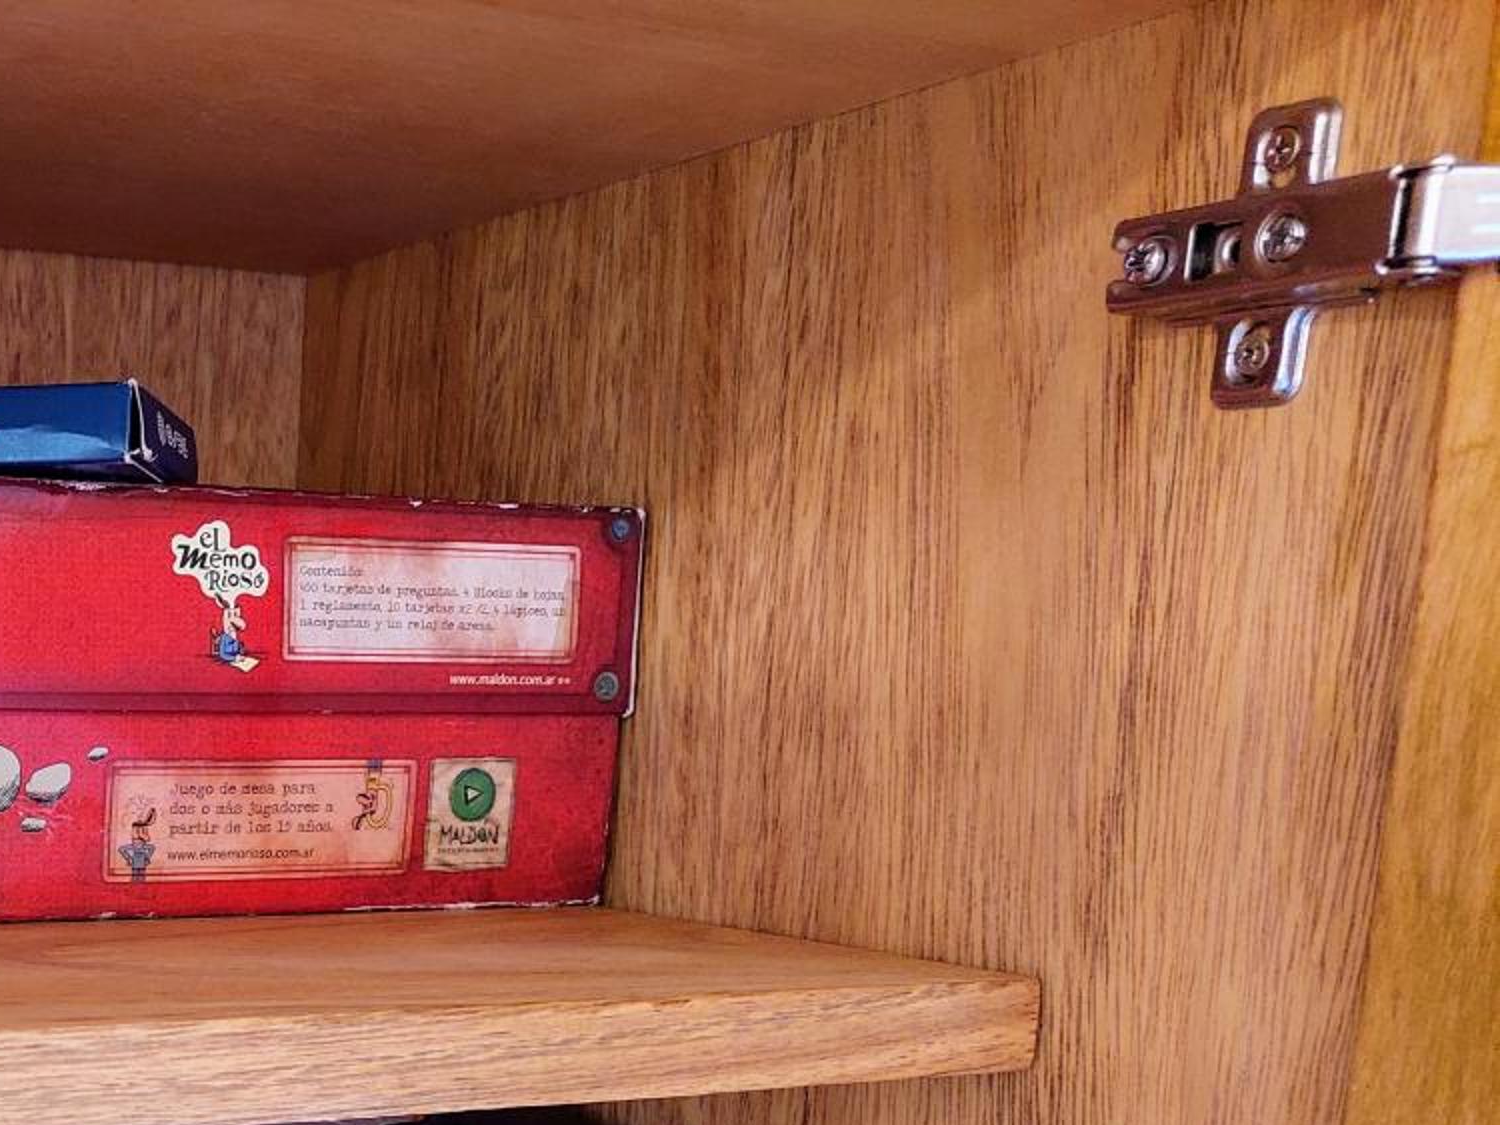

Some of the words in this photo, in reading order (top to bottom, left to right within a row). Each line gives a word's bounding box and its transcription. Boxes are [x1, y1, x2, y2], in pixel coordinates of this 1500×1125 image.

[177, 543, 256, 571] Memo
[377, 584, 392, 595] de
[388, 601, 401, 613] 10
[374, 619, 383, 630] y
[170, 783, 215, 798] Juego
[219, 782, 237, 795] de
[282, 783, 316, 799] para
[170, 802, 196, 815] dos
[201, 805, 211, 814] o
[247, 801, 320, 818] jugadores
[169, 821, 220, 838] partir
[224, 821, 241, 833] de
[249, 821, 272, 833] los
